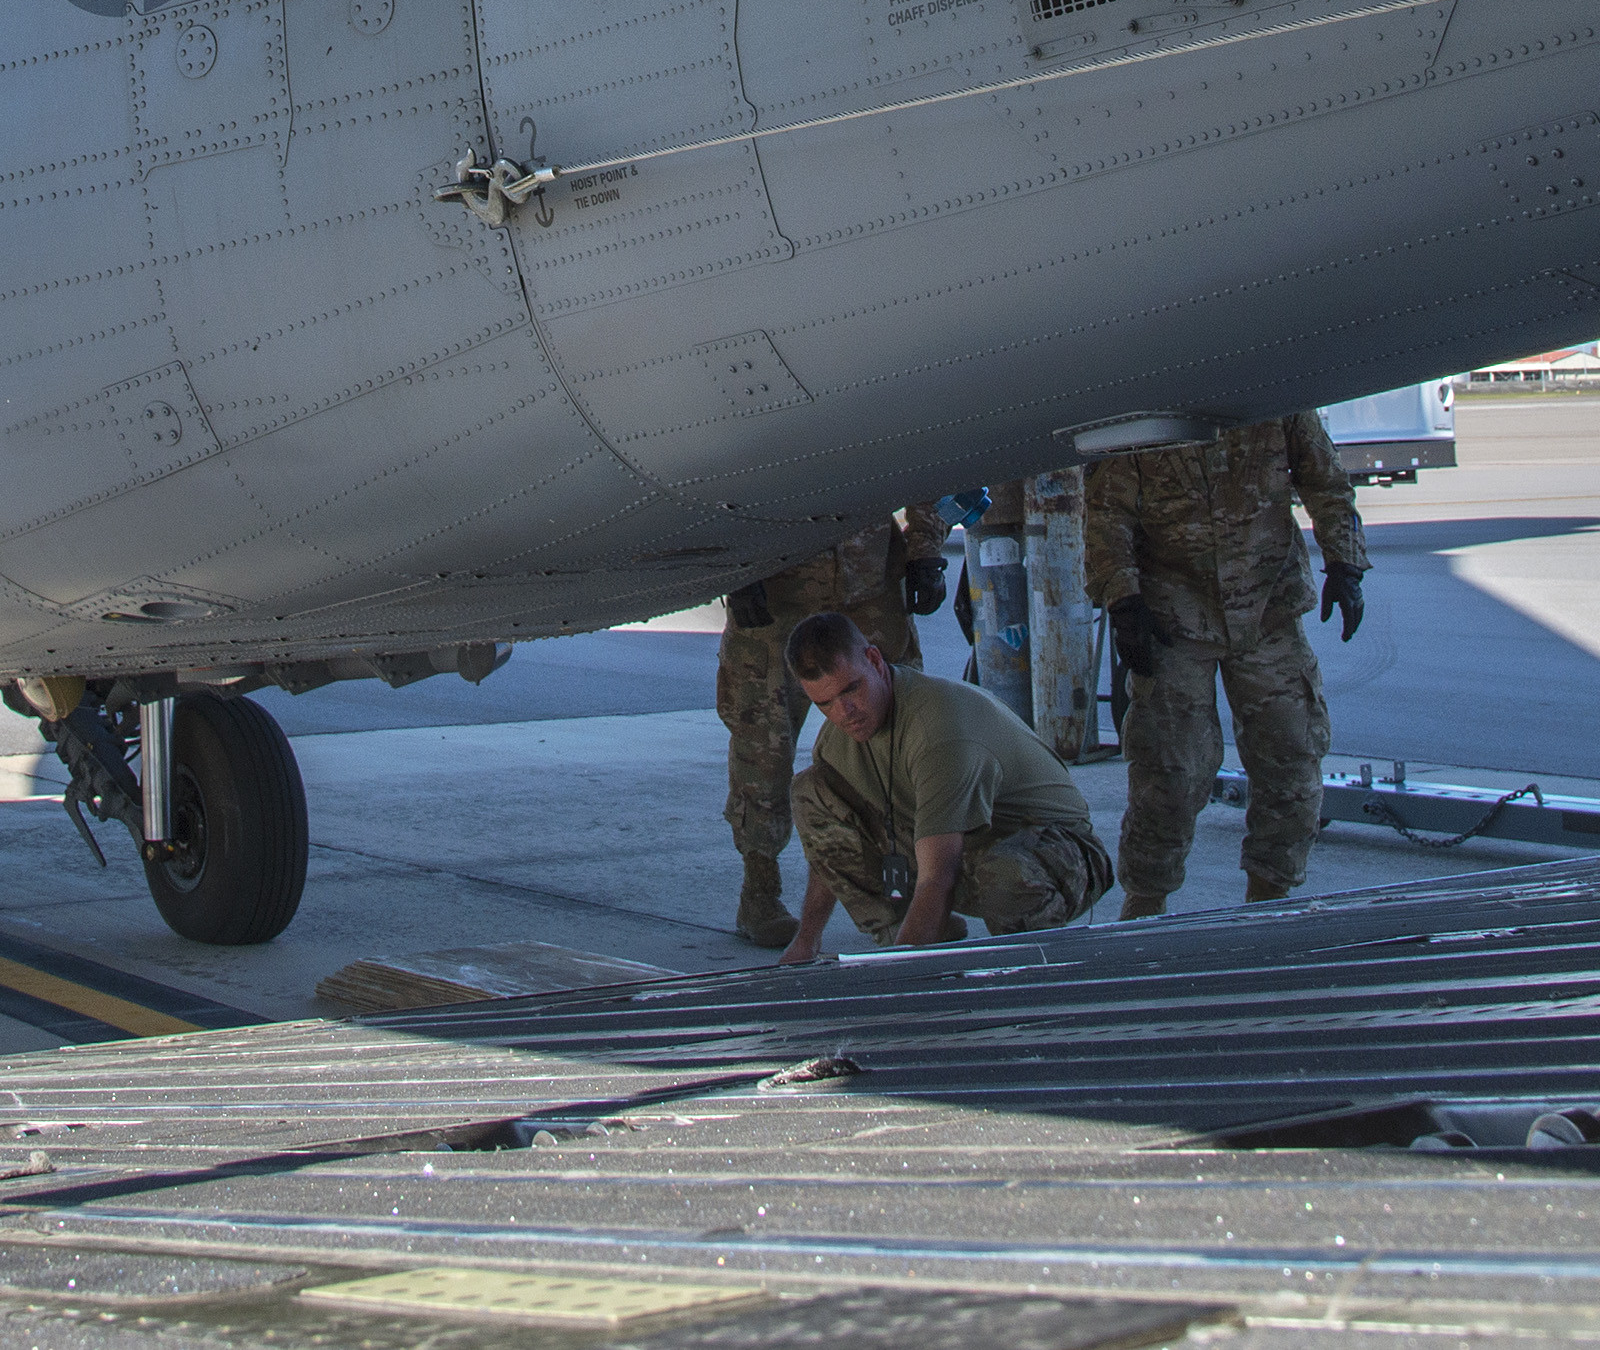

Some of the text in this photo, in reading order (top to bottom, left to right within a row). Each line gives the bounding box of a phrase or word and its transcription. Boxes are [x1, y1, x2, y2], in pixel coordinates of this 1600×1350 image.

[887, 4, 925, 26] CHAFF
[570, 164, 639, 192] HOIST POINT &
[574, 188, 621, 210] TIE DOWN
